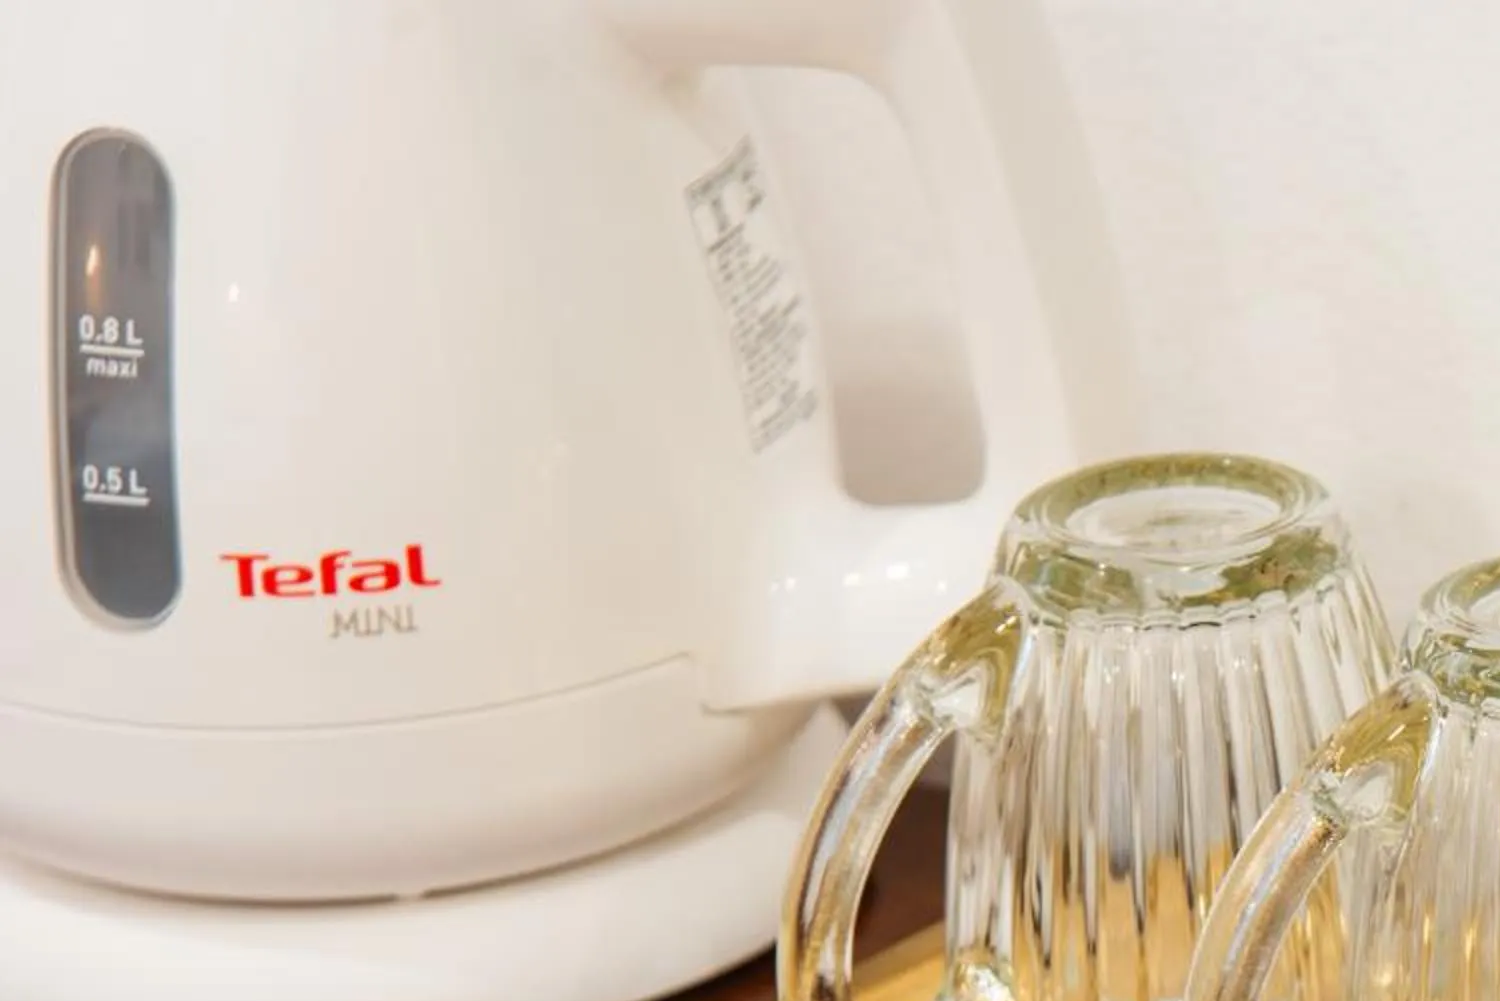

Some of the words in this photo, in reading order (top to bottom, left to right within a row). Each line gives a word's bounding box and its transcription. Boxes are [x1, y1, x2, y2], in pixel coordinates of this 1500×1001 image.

[79, 314, 120, 345] 0.8
[125, 318, 144, 346] L
[86, 356, 138, 378] maxi
[82, 463, 123, 494] 0.5
[128, 467, 148, 495] L
[219, 543, 441, 598] Tefal
[330, 604, 418, 639] MINI
